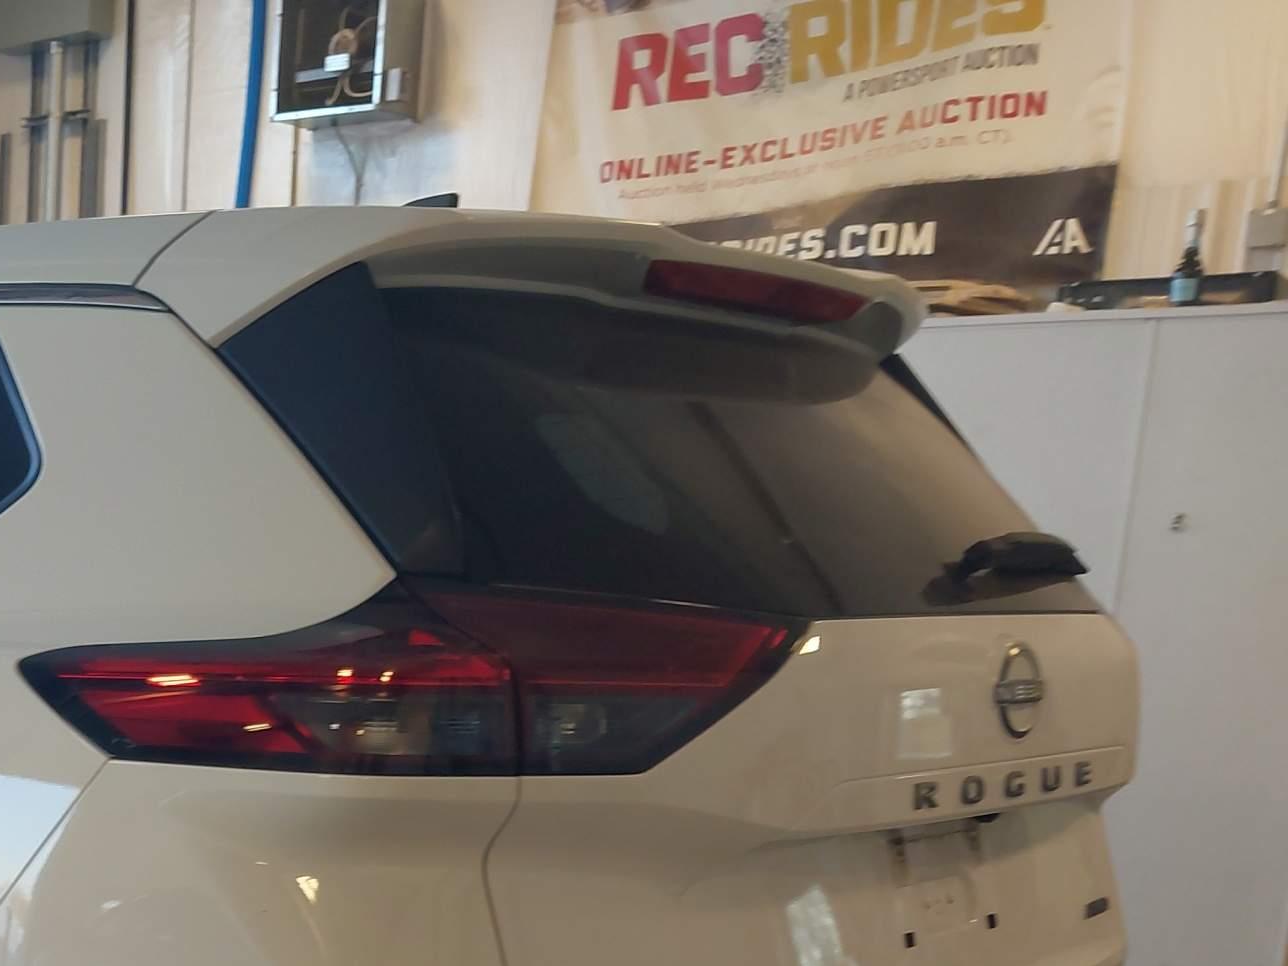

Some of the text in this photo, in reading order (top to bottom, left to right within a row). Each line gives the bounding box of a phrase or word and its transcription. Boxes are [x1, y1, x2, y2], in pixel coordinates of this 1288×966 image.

[611, 12, 766, 111] REC
[962, 43, 1040, 72] AUCTION
[600, 115, 889, 184] ONLINE-EXCLUSIVE
[896, 91, 1049, 135] AUCTION
[913, 761, 1092, 810] ROGUE
